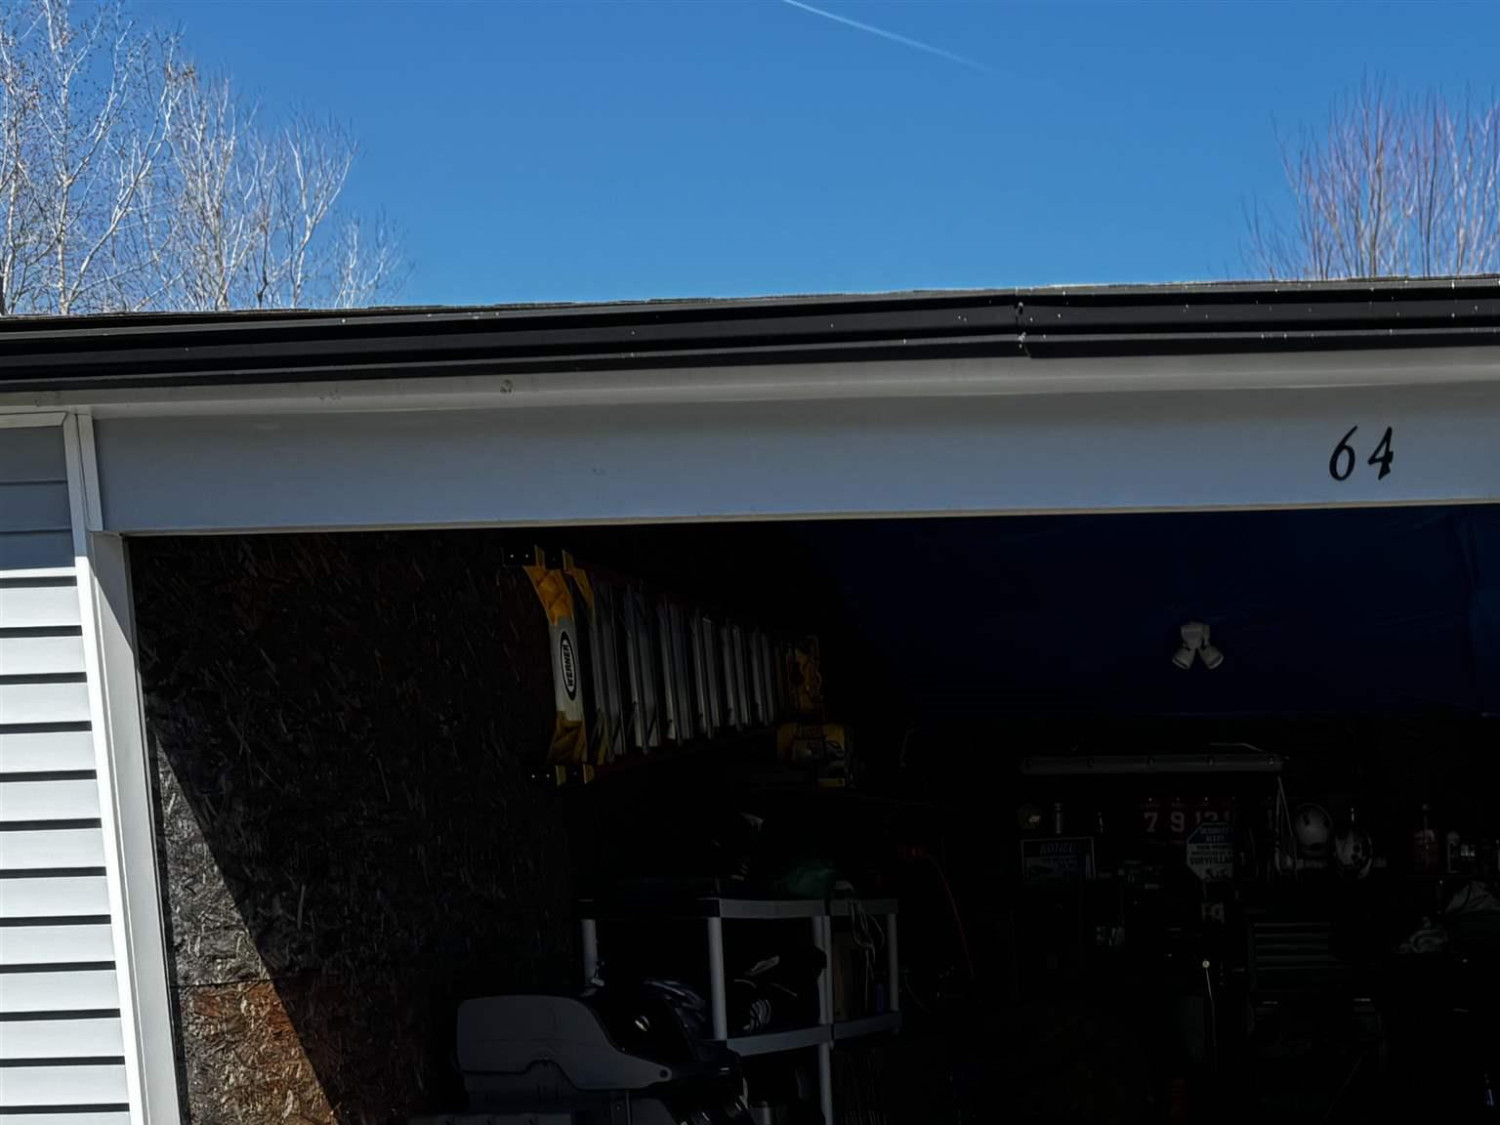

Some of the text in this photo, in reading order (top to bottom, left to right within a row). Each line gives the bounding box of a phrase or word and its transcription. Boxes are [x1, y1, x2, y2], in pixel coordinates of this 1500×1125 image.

[1329, 425, 1394, 481] 64
[562, 645, 573, 686] WERNER
[1144, 812, 1158, 832] 7
[1170, 811, 1186, 832] 9
